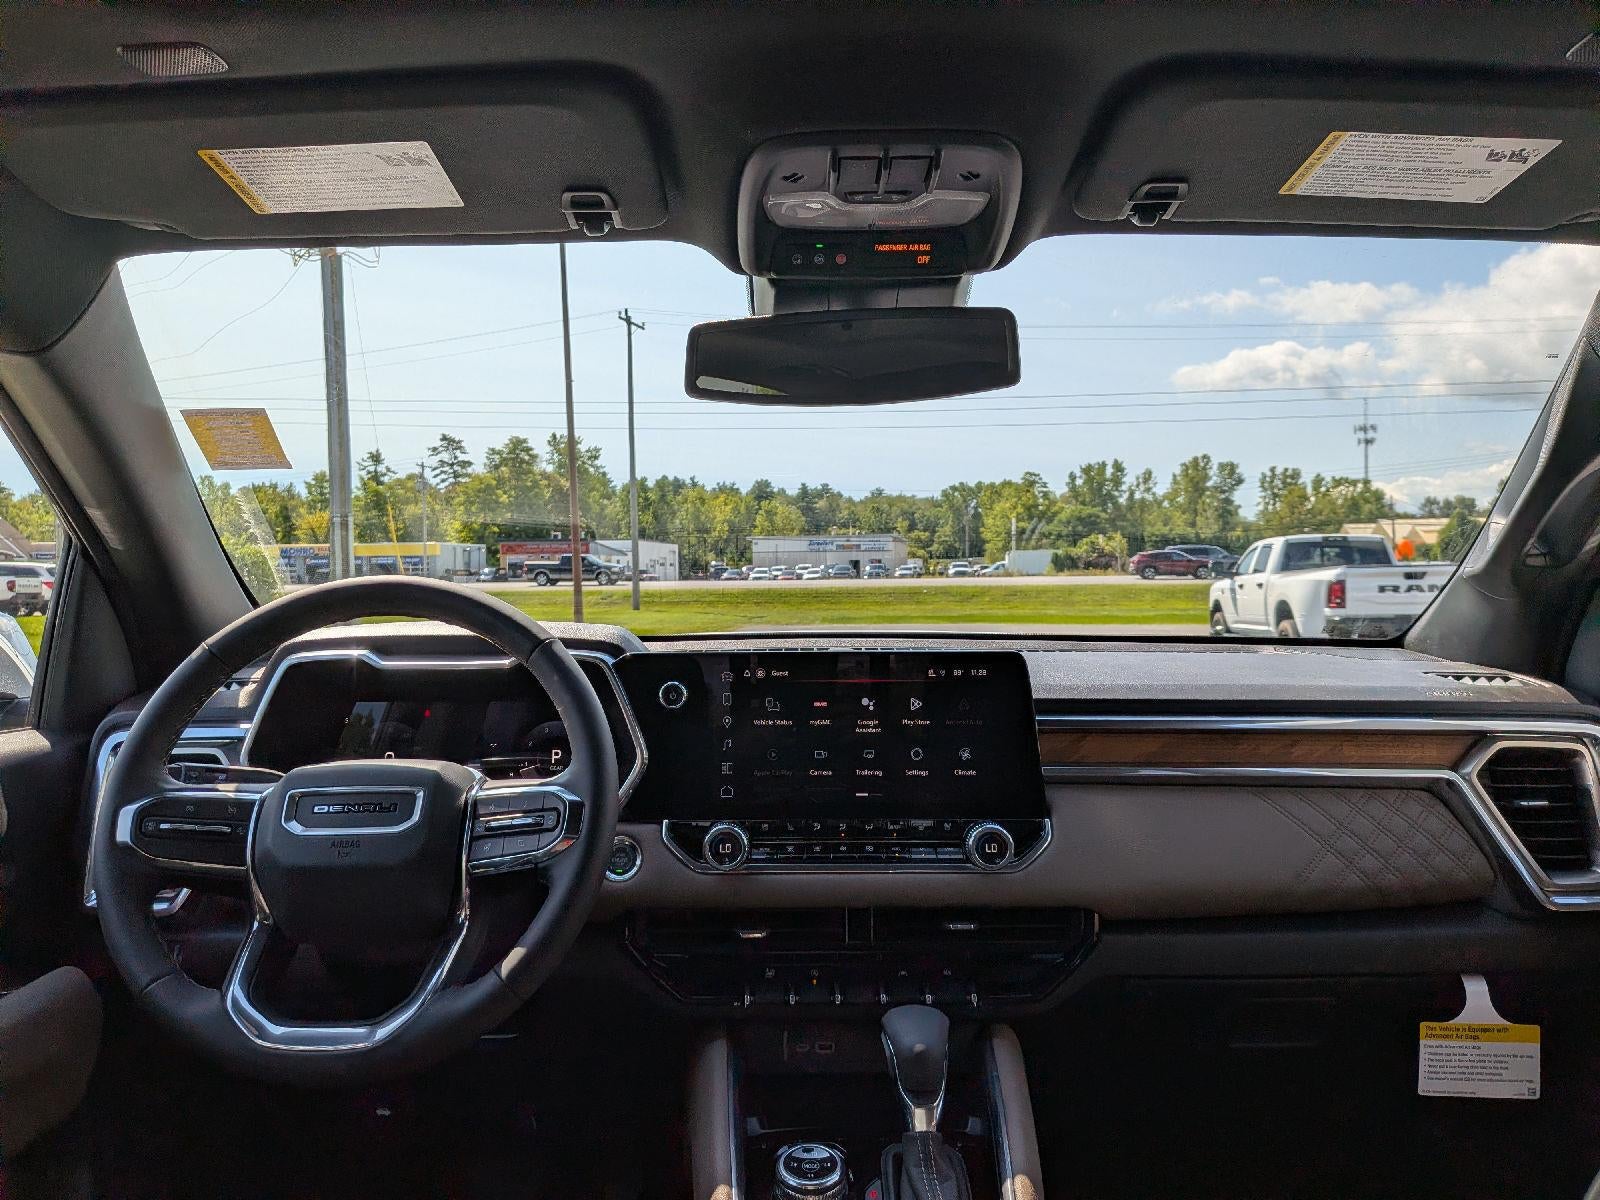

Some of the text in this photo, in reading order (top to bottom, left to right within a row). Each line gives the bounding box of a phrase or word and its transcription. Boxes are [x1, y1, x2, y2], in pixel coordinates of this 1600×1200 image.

[917, 255, 931, 264] OFF
[857, 719, 879, 727] Google
[902, 719, 914, 727] Play
[551, 749, 562, 764] P
[855, 769, 883, 777] Trailering
[905, 769, 929, 777] Settings
[313, 802, 399, 814] DENALI
[329, 840, 361, 849] AIRBAG
[1424, 1024, 1437, 1032] This
[1467, 1026, 1495, 1034] Equipped
